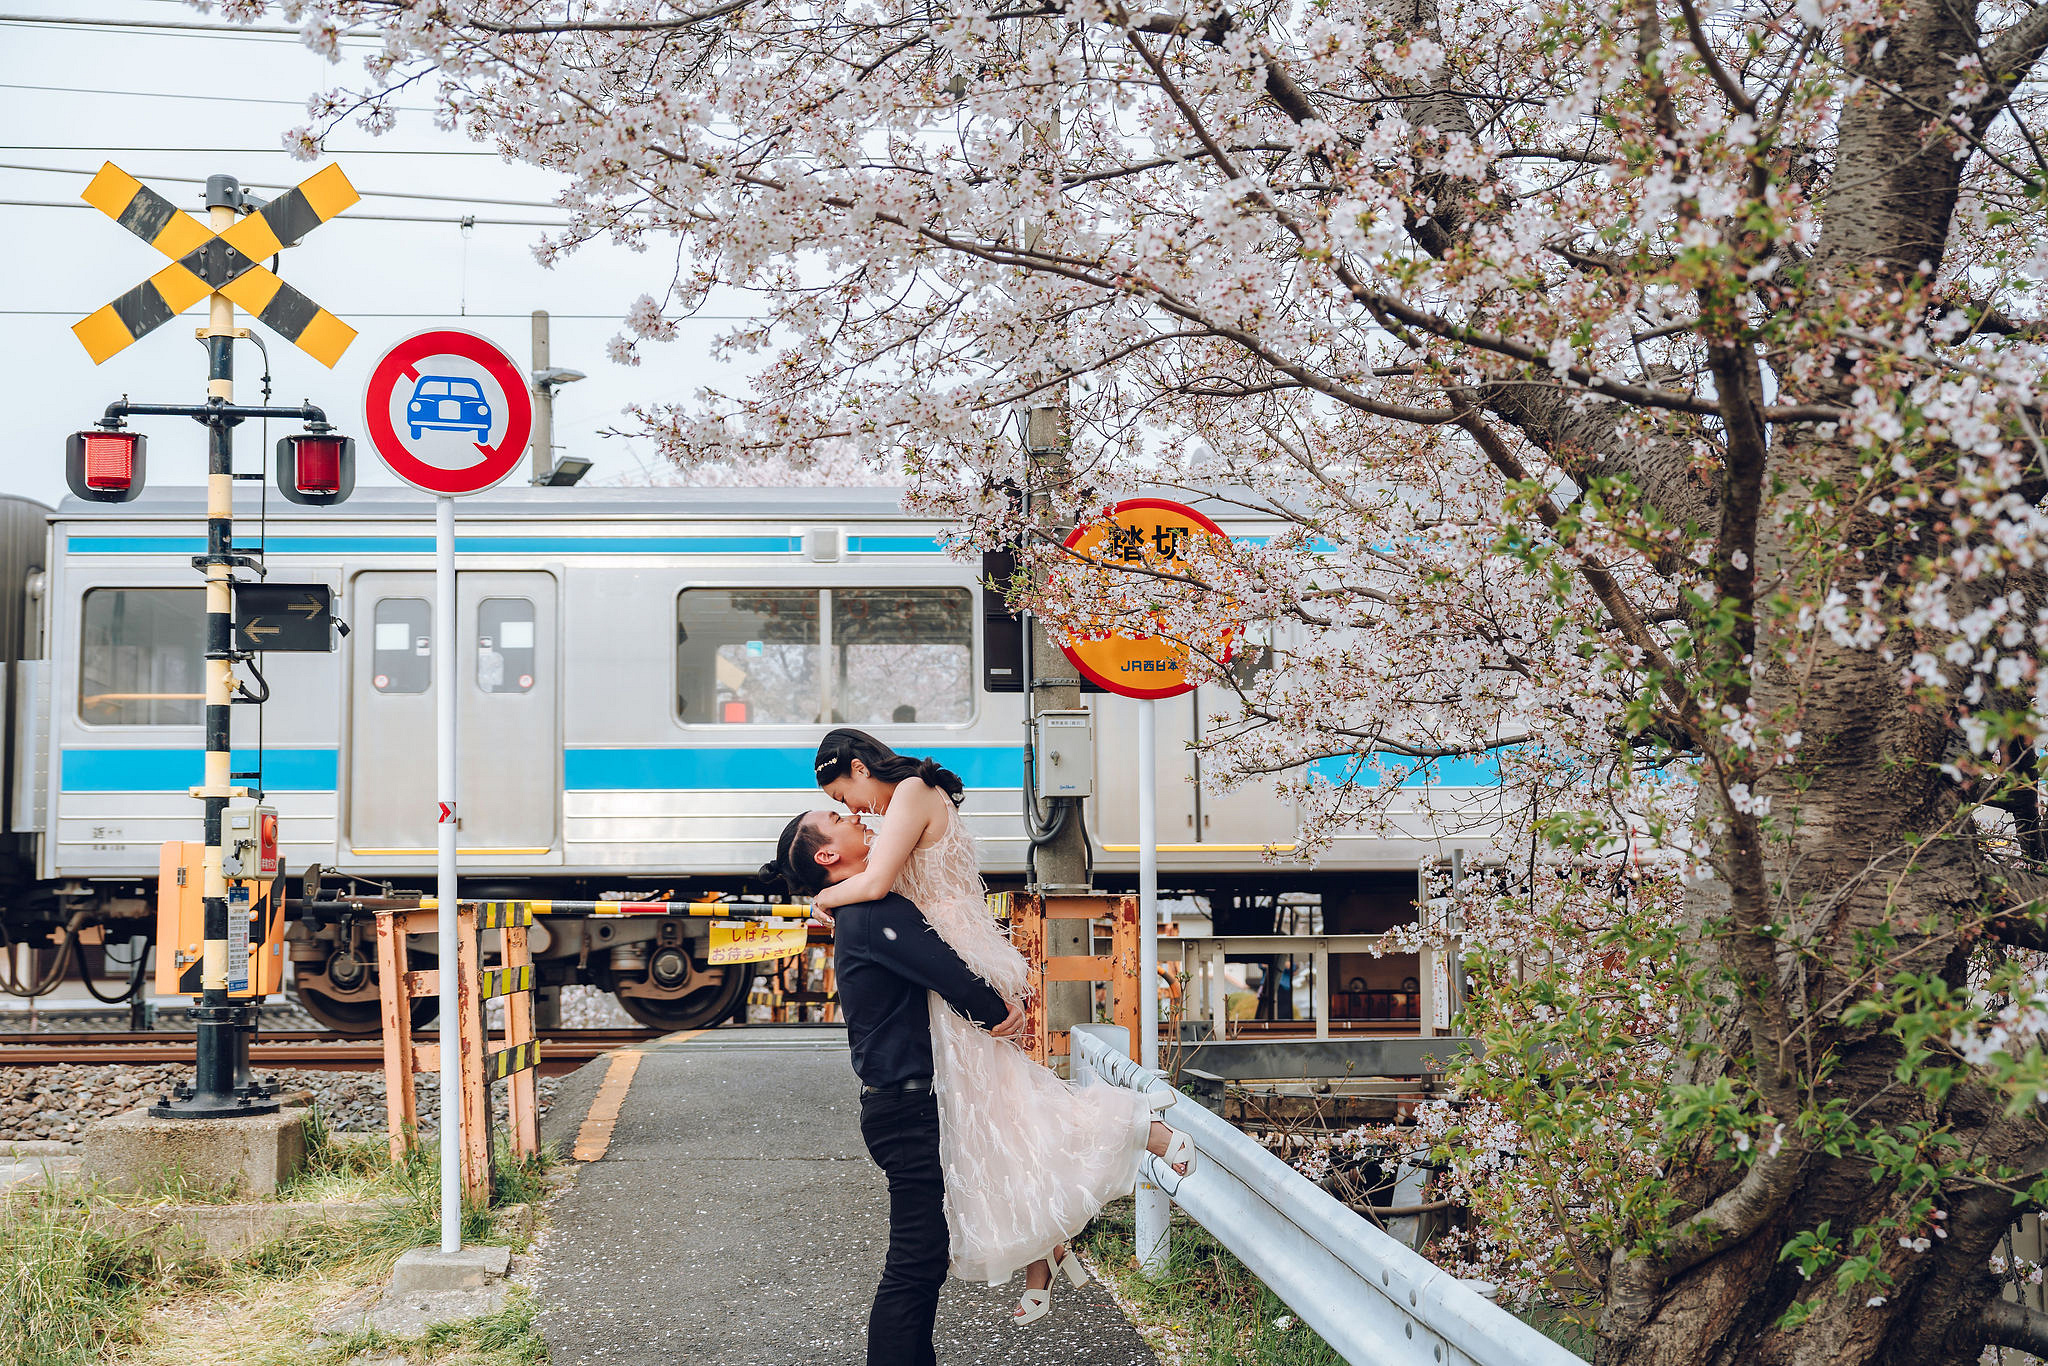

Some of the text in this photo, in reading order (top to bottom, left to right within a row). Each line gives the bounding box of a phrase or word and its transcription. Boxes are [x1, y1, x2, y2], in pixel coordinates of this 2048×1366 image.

[1107, 524, 1190, 562] 踏切
[1120, 660, 1180, 673] JR西日本
[732, 929, 784, 943] しばらく
[711, 947, 801, 962] お待ち下さい
